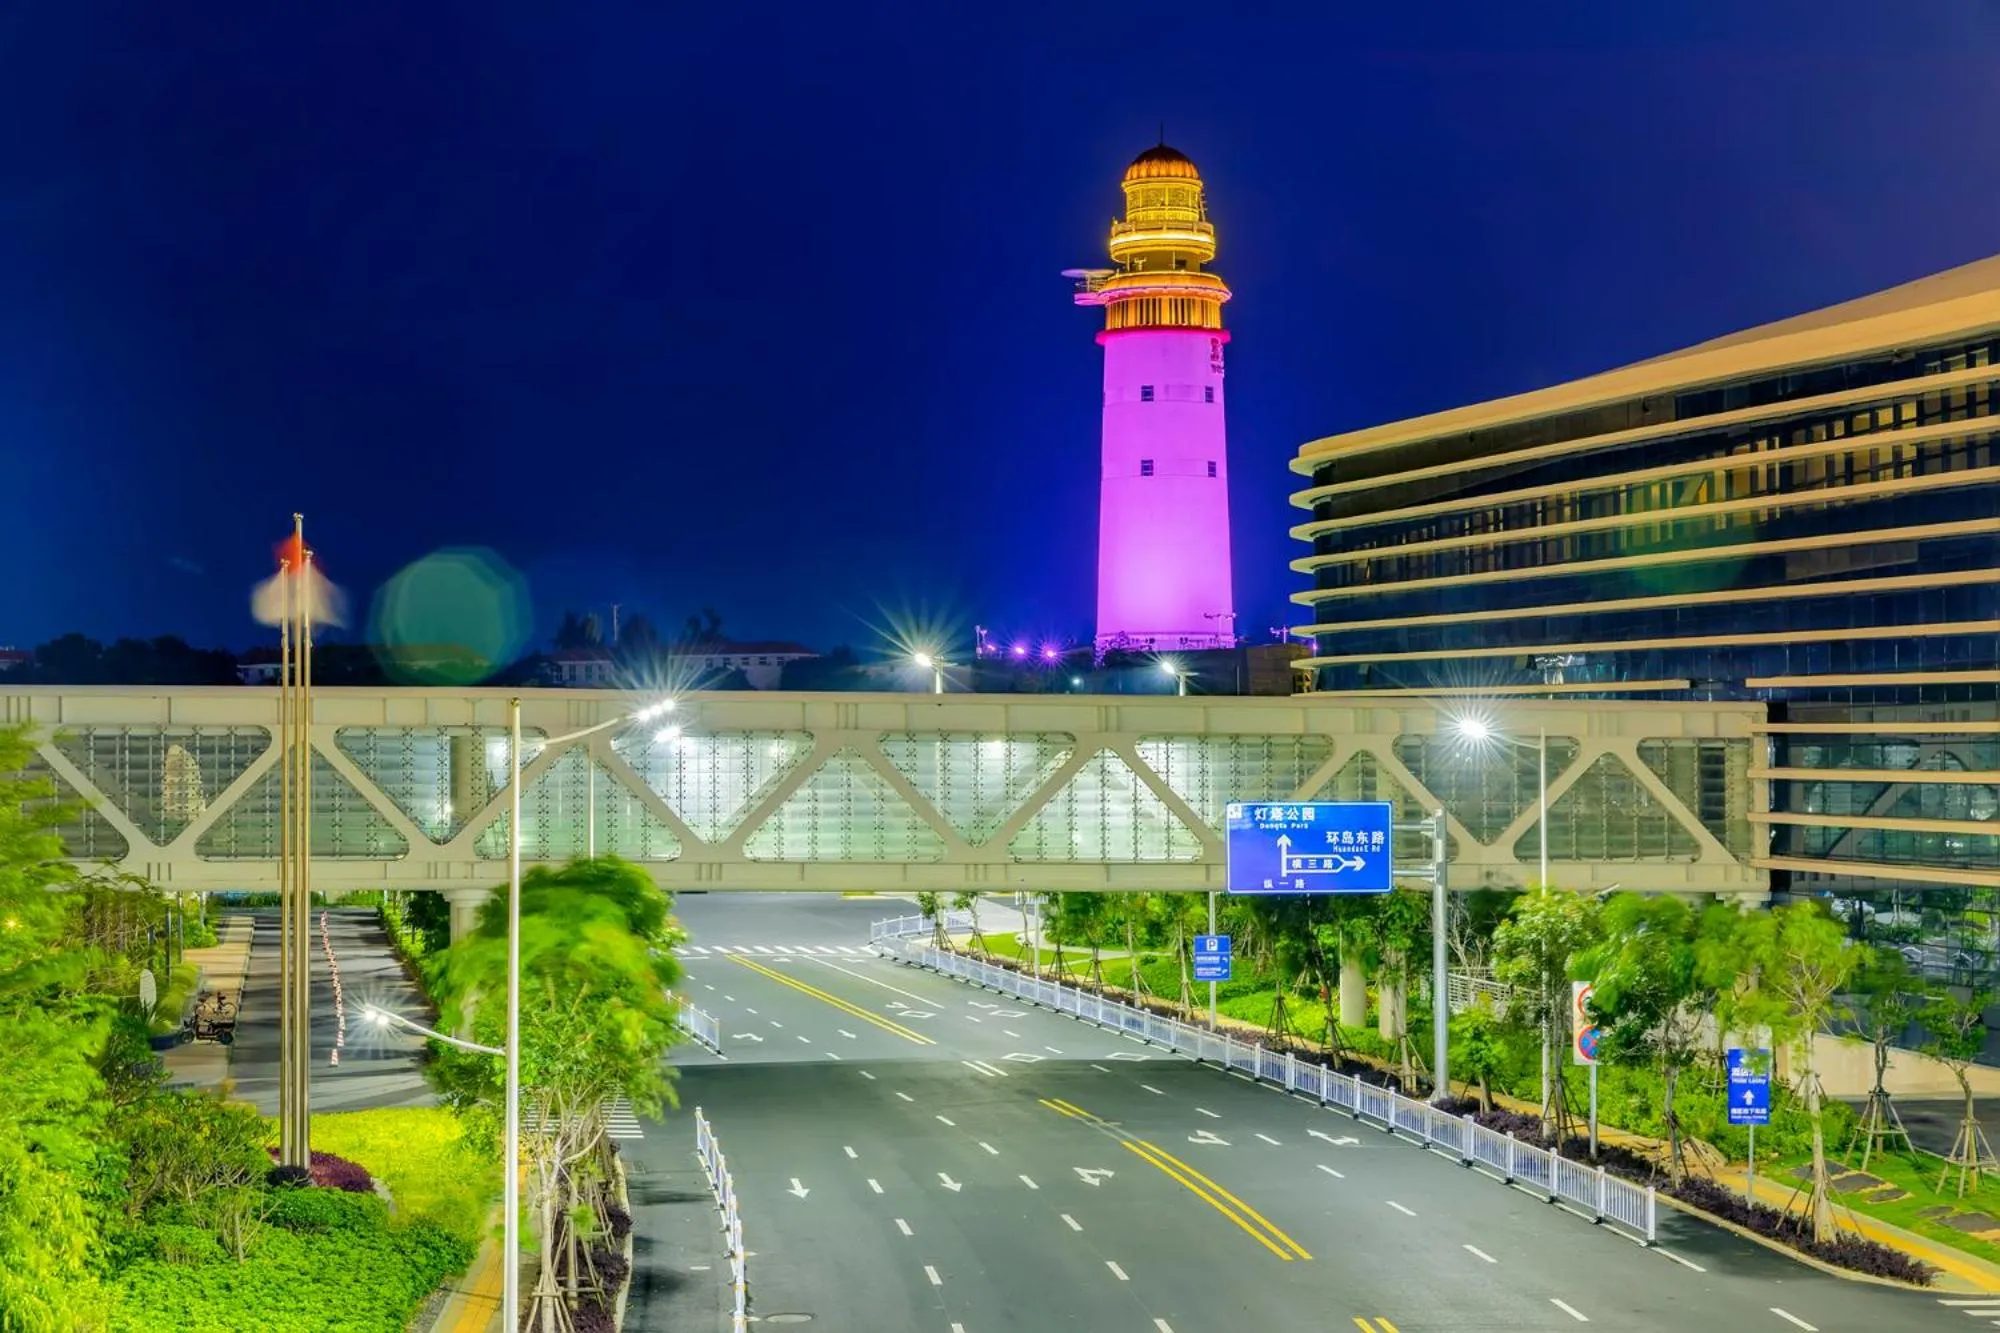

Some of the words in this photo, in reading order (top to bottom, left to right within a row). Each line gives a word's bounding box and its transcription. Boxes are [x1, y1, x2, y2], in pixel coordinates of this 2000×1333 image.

[1254, 807, 1315, 821] 灯塔公园
[1326, 831, 1384, 844] 环岛东路
[1292, 859, 1333, 869] 横三路
[1263, 879, 1304, 888] 纵一路
[1208, 940, 1216, 949] P
